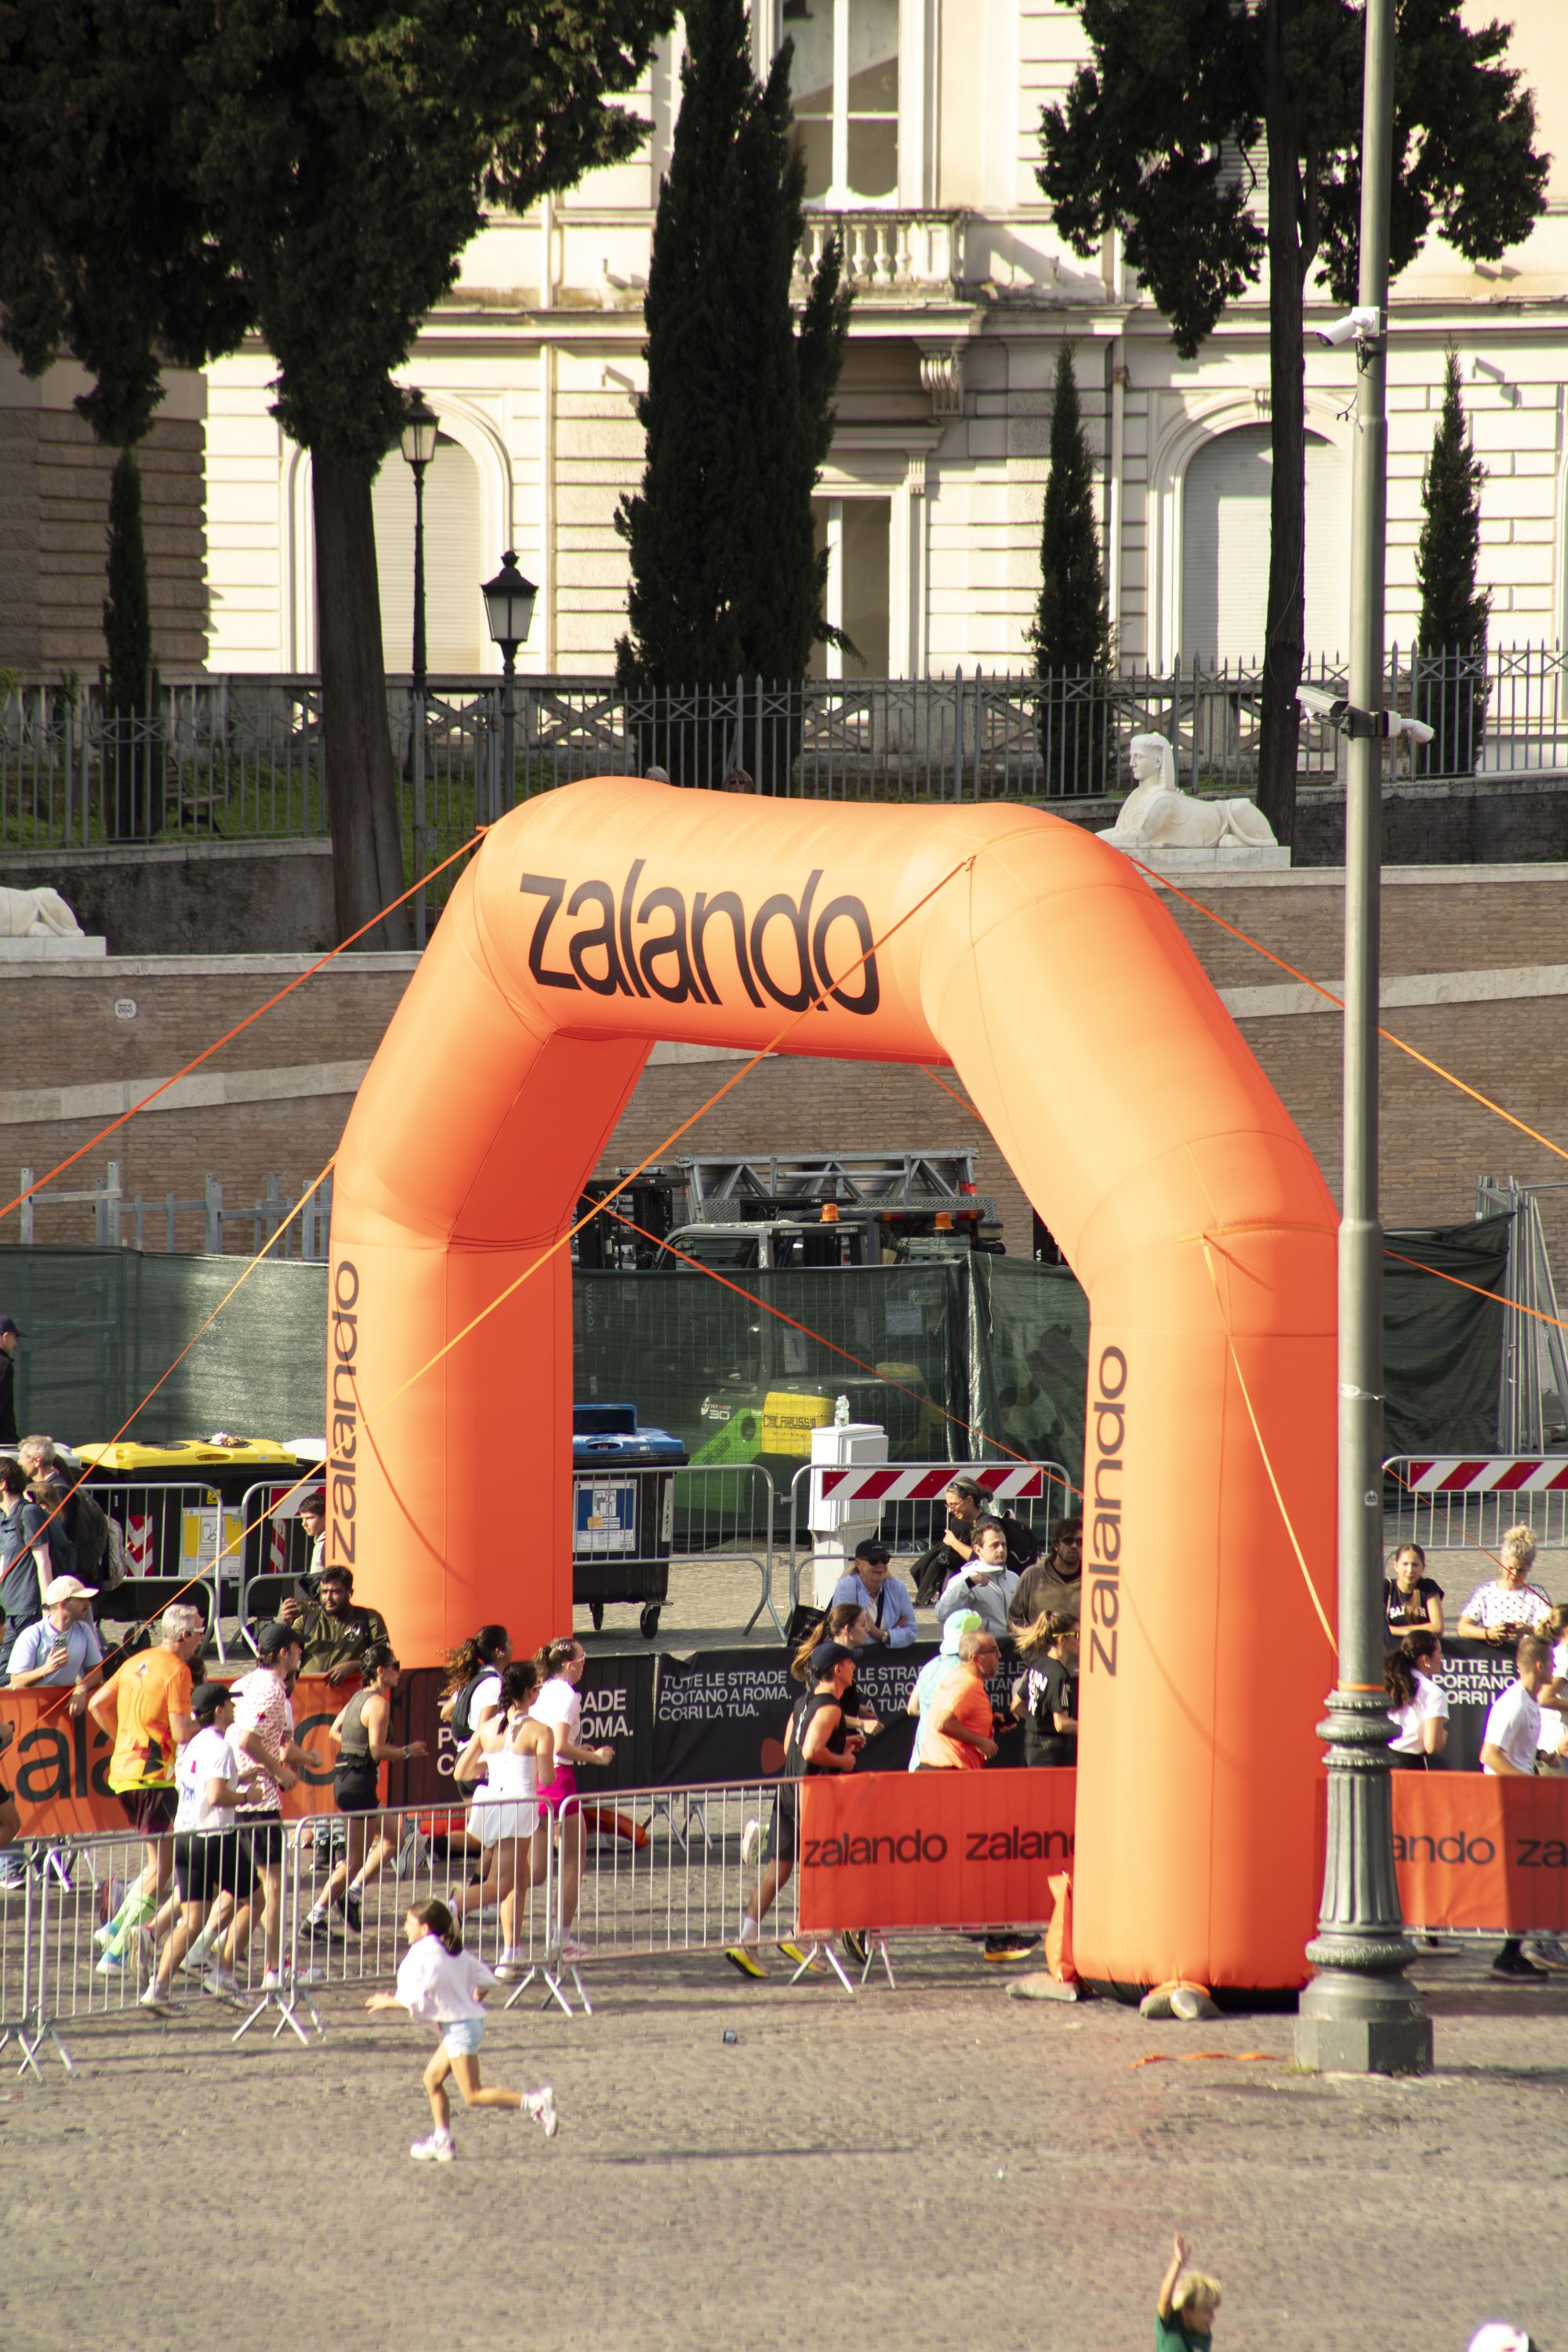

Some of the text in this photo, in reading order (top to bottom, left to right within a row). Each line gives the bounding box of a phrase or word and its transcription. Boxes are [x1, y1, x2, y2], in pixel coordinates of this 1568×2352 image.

[519, 858, 880, 1015] zalando
[330, 1261, 360, 1564] zalando
[1089, 1345, 1127, 1678] zalando
[857, 1665, 920, 1682] LE STRA
[1440, 1658, 1514, 1674] UTTE LE
[706, 1672, 725, 1687] LE
[728, 1670, 788, 1686] STRADE
[1432, 1674, 1518, 1690] PORTANO
[579, 1688, 627, 1714] ADE
[730, 1687, 741, 1702] A
[743, 1686, 792, 1701] ROMA.
[1446, 1689, 1488, 1706] ORRI
[659, 1703, 760, 1722] CORRI LA TUA.
[877, 1698, 908, 1712] TUA
[579, 1715, 634, 1740] OMA.
[803, 1825, 1076, 1868] zalando zalan
[1392, 1831, 1496, 1866] ando
